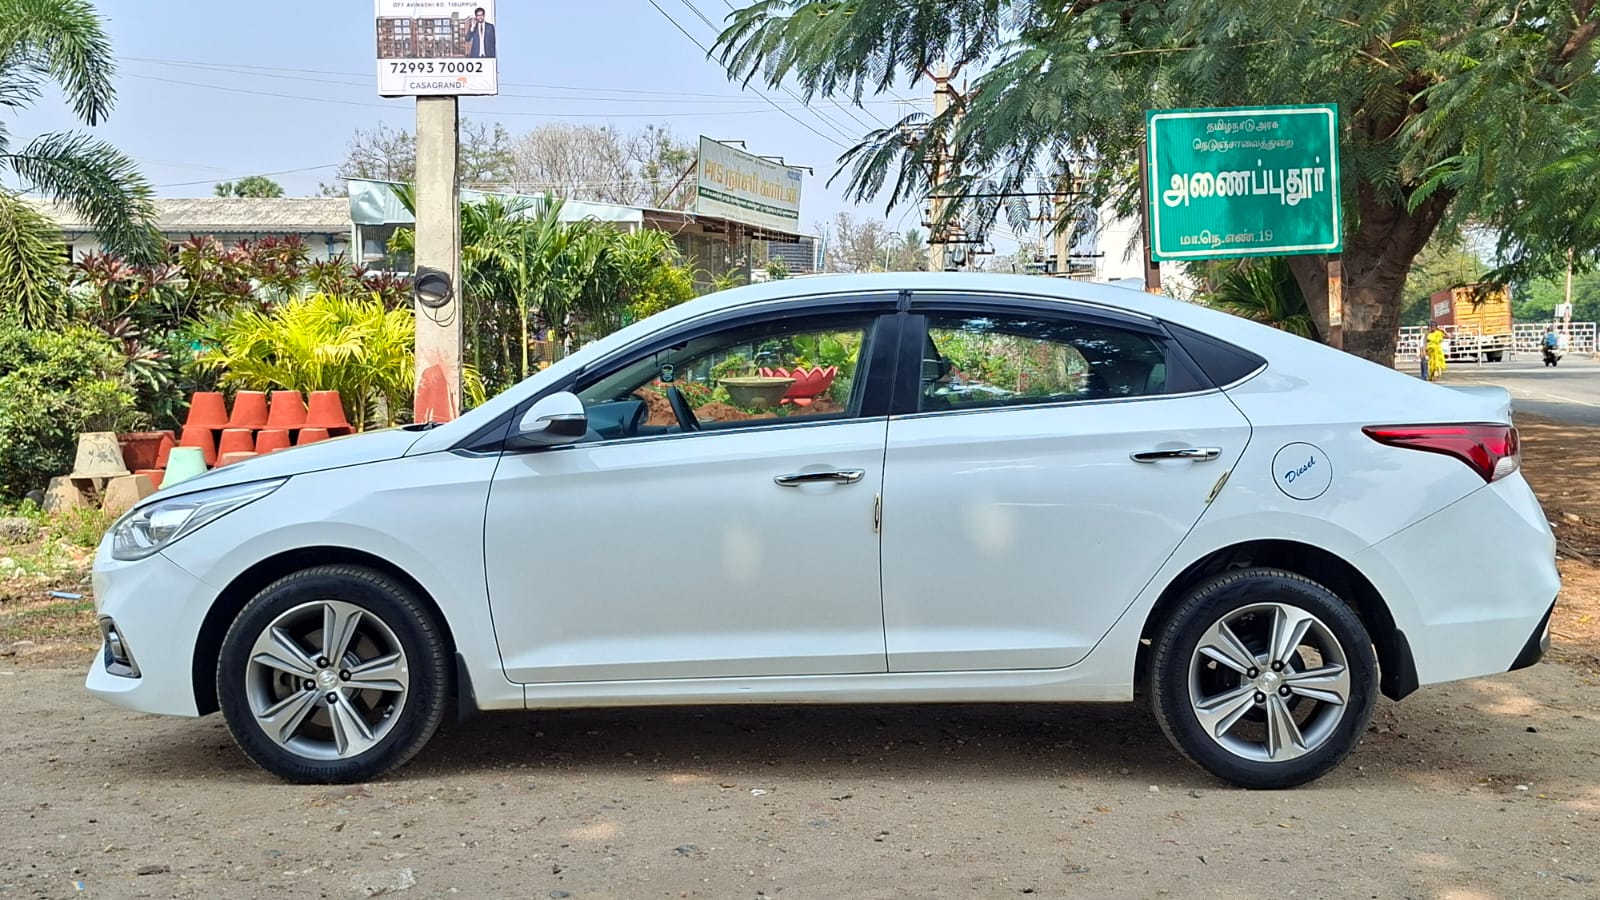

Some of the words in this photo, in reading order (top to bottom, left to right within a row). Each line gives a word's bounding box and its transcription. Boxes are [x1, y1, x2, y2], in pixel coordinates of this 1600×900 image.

[390, 62, 434, 73] 72993
[439, 62, 483, 73] 70002
[410, 81, 462, 89] CASAGRAND
[1206, 119, 1255, 134] தமிழ்நாடு
[1255, 120, 1280, 132] அரசு
[1193, 137, 1294, 152] நெடுஞ்சாலைத்துறை
[704, 161, 723, 183] PKS
[1163, 156, 1325, 208] அணைப்புதூர்
[1285, 455, 1316, 483] Diesel
